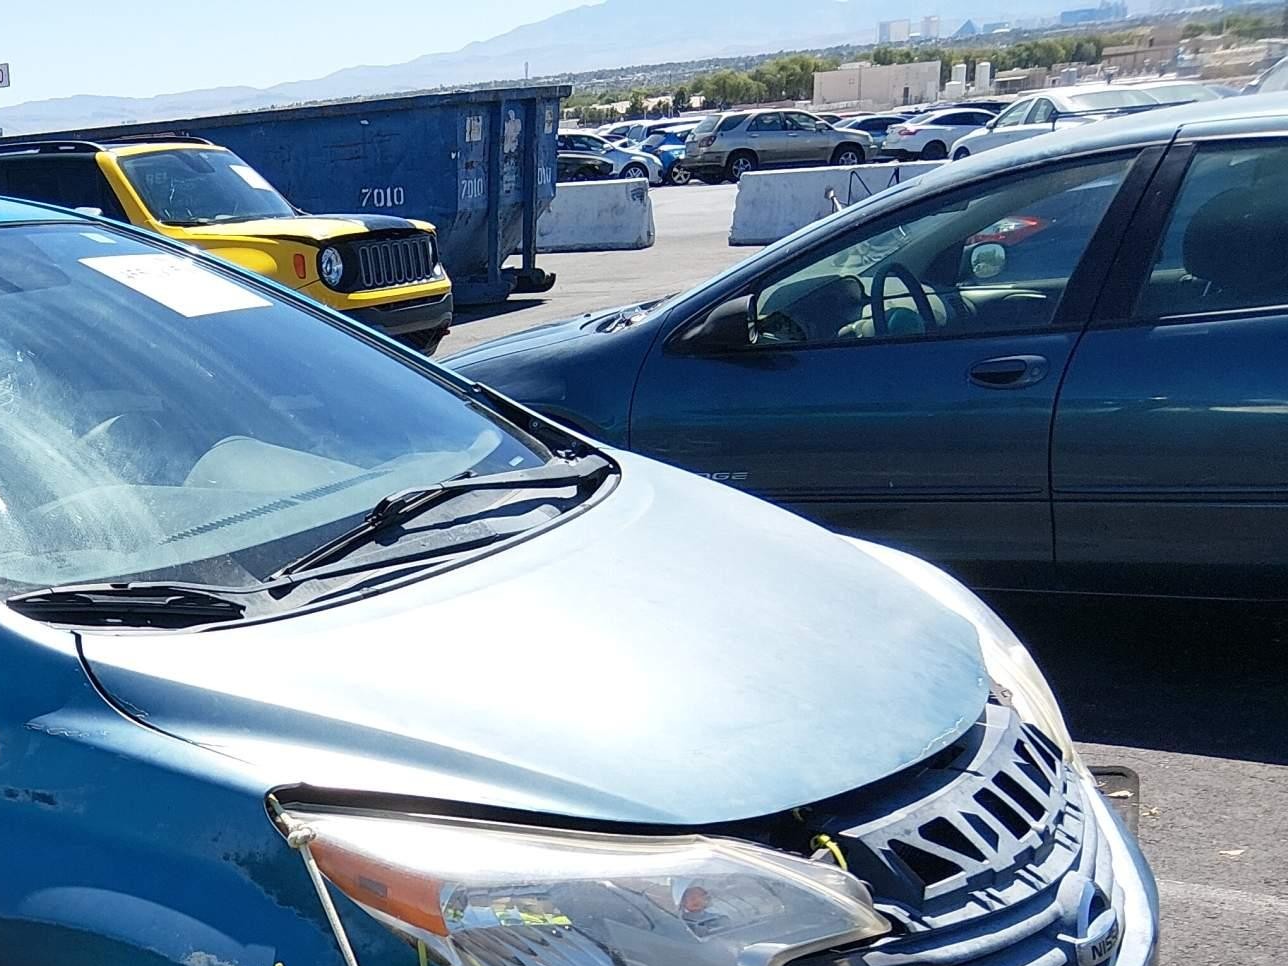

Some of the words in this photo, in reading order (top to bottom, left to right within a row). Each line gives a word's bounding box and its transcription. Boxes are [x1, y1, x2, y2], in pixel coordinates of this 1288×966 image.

[361, 187, 405, 207] 7010
[461, 178, 484, 200] 7010
[1091, 928, 1119, 961] NISS
